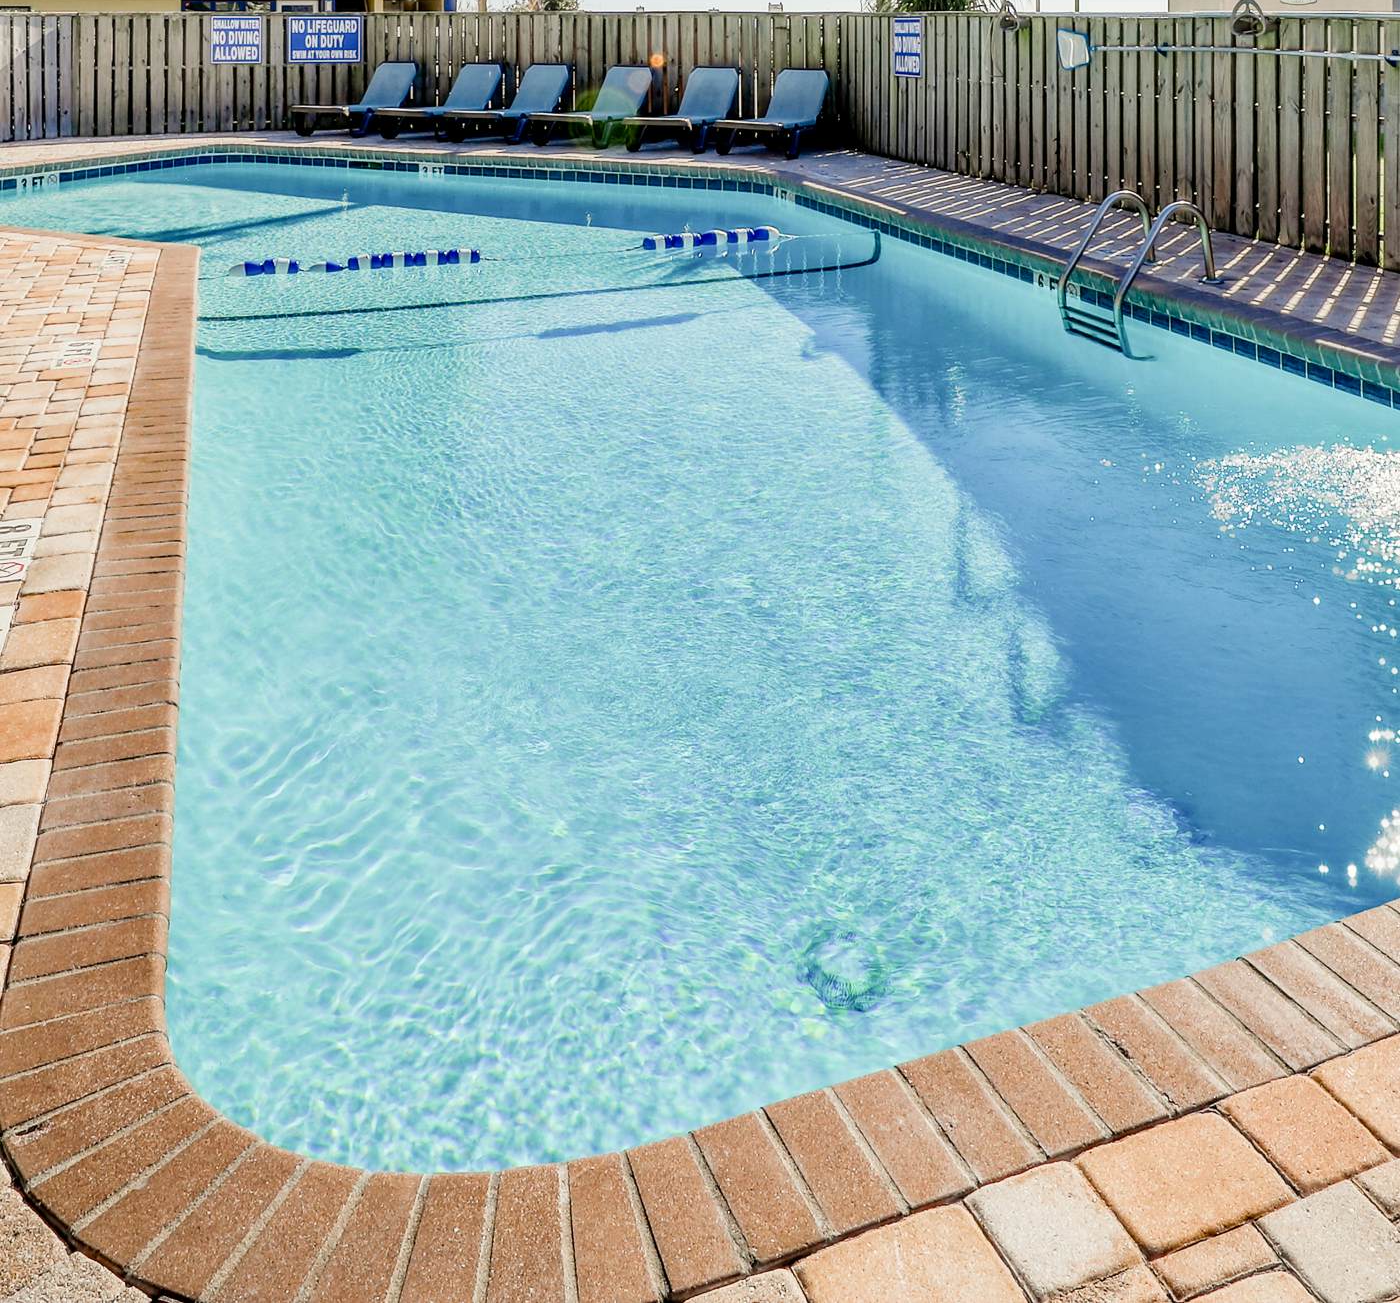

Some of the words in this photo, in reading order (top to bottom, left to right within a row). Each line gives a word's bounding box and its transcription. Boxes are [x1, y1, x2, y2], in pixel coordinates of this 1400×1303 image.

[213, 19, 240, 29] SHALLOW
[240, 19, 259, 29] WATER
[291, 19, 305, 34] NO
[307, 19, 358, 34] LIFEGUARD
[213, 31, 226, 45] NO
[229, 31, 259, 45] DIVING
[305, 34, 318, 48] ON
[320, 34, 344, 48] DUTY
[214, 46, 258, 60] ALLOWED
[292, 50, 307, 60] SWIM
[308, 50, 315, 59] AT
[315, 50, 330, 59] YOUR
[331, 50, 343, 59] OWN
[344, 50, 358, 59] RISK
[432, 166, 443, 174] FT
[32, 176, 44, 186] FT
